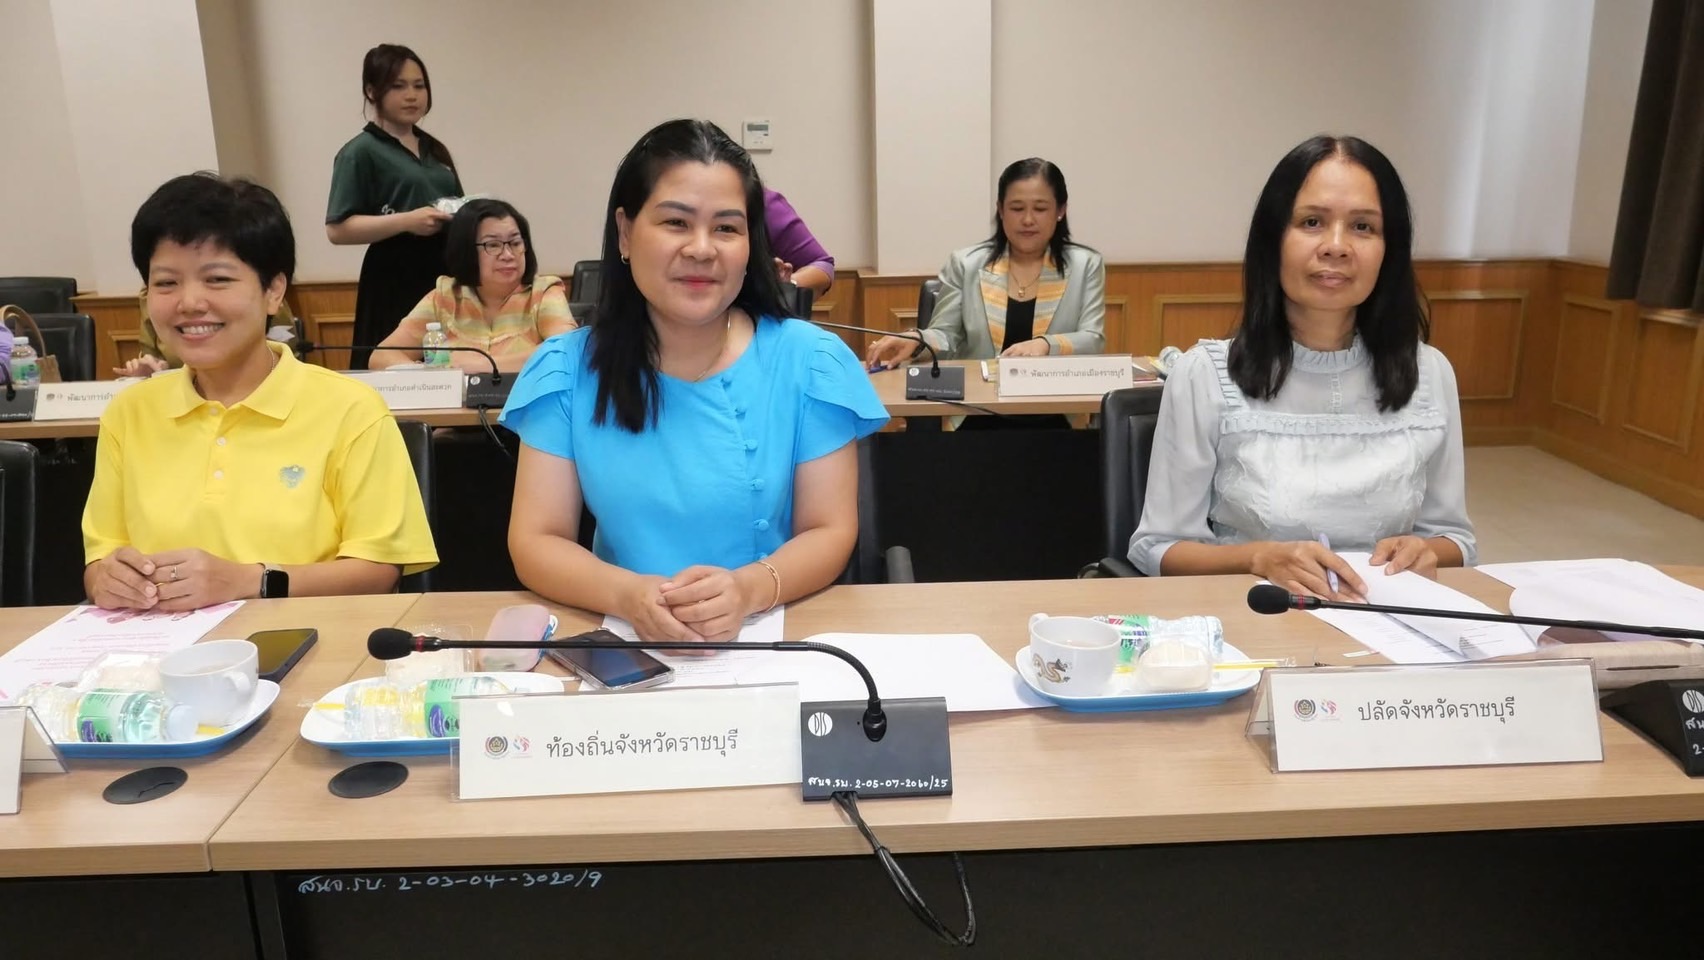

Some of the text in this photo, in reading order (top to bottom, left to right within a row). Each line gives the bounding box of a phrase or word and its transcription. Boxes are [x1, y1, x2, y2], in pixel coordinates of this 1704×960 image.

[1357, 696, 1516, 724] ปลัดจังหวัดราชบุรี
[545, 728, 740, 759] ท้องถิ่นจังหวัดราชบุรี
